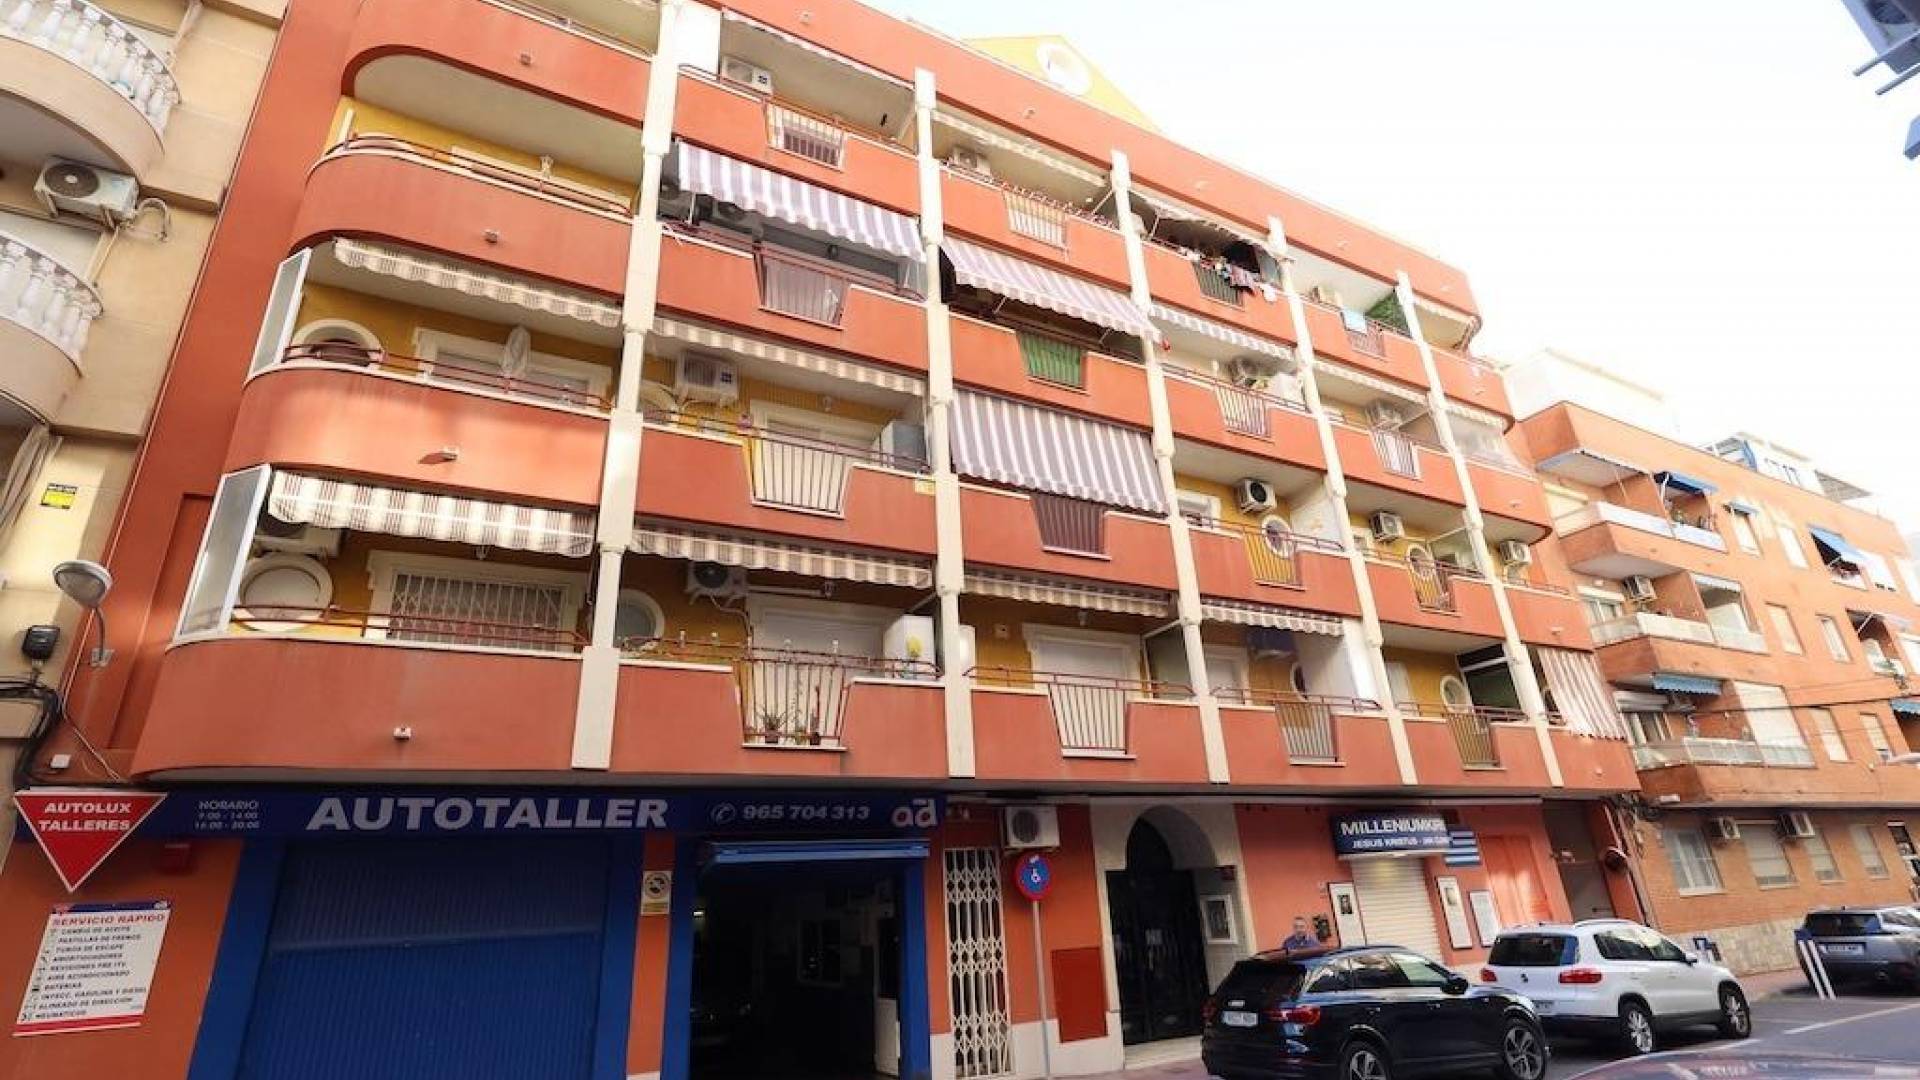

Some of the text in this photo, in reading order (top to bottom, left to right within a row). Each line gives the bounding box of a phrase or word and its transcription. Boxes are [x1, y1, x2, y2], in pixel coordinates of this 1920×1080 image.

[44, 802, 133, 814] AUTOLUX
[198, 800, 260, 810] HORARIO
[306, 797, 669, 830] AUTOTALLER
[743, 804, 871, 820] 965 704 313
[38, 819, 131, 832] TALLERES
[52, 915, 114, 926] SERVICIO
